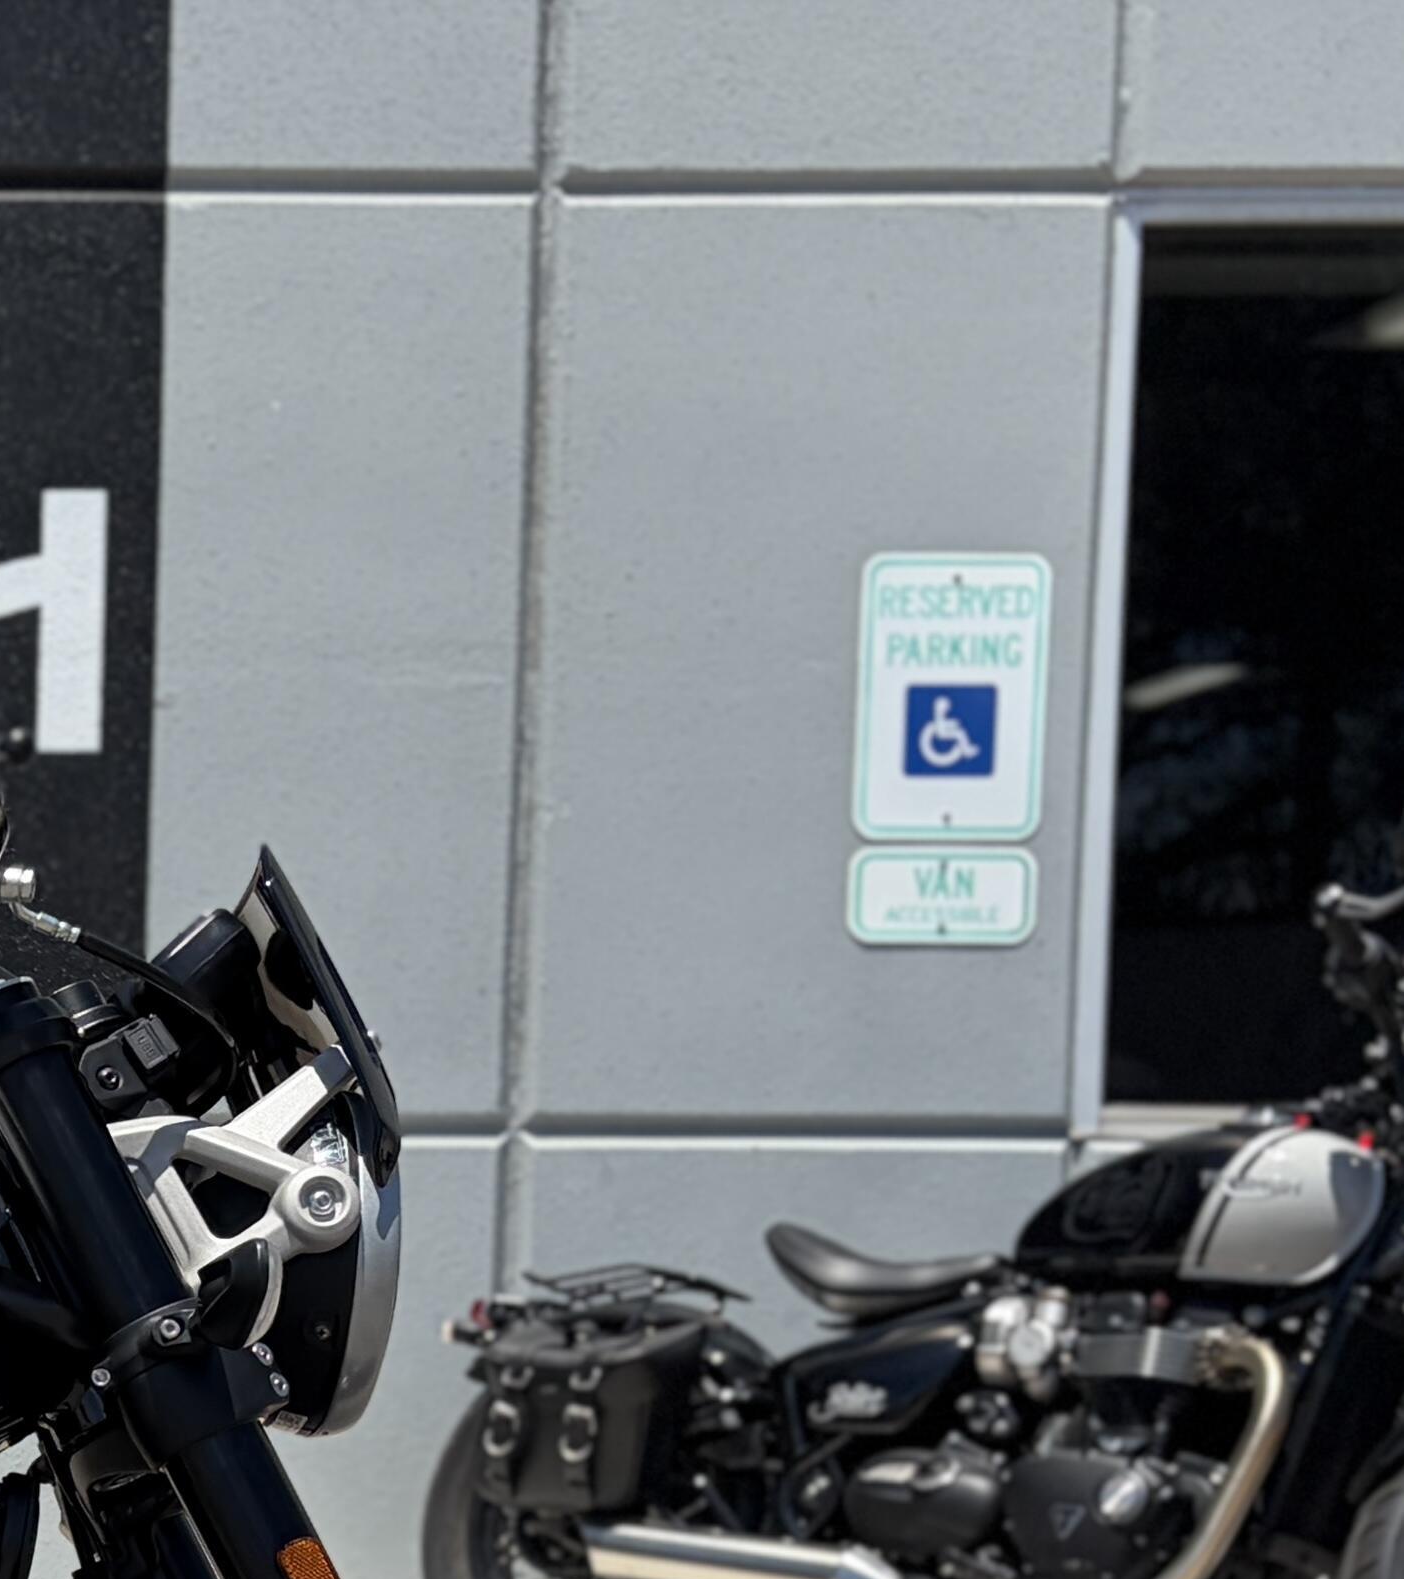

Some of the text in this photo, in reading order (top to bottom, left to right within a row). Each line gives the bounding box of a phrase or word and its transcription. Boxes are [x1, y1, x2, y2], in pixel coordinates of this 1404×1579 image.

[879, 584, 1036, 619] RESERVED
[886, 633, 1024, 668] PARKING
[914, 866, 976, 900] VAN
